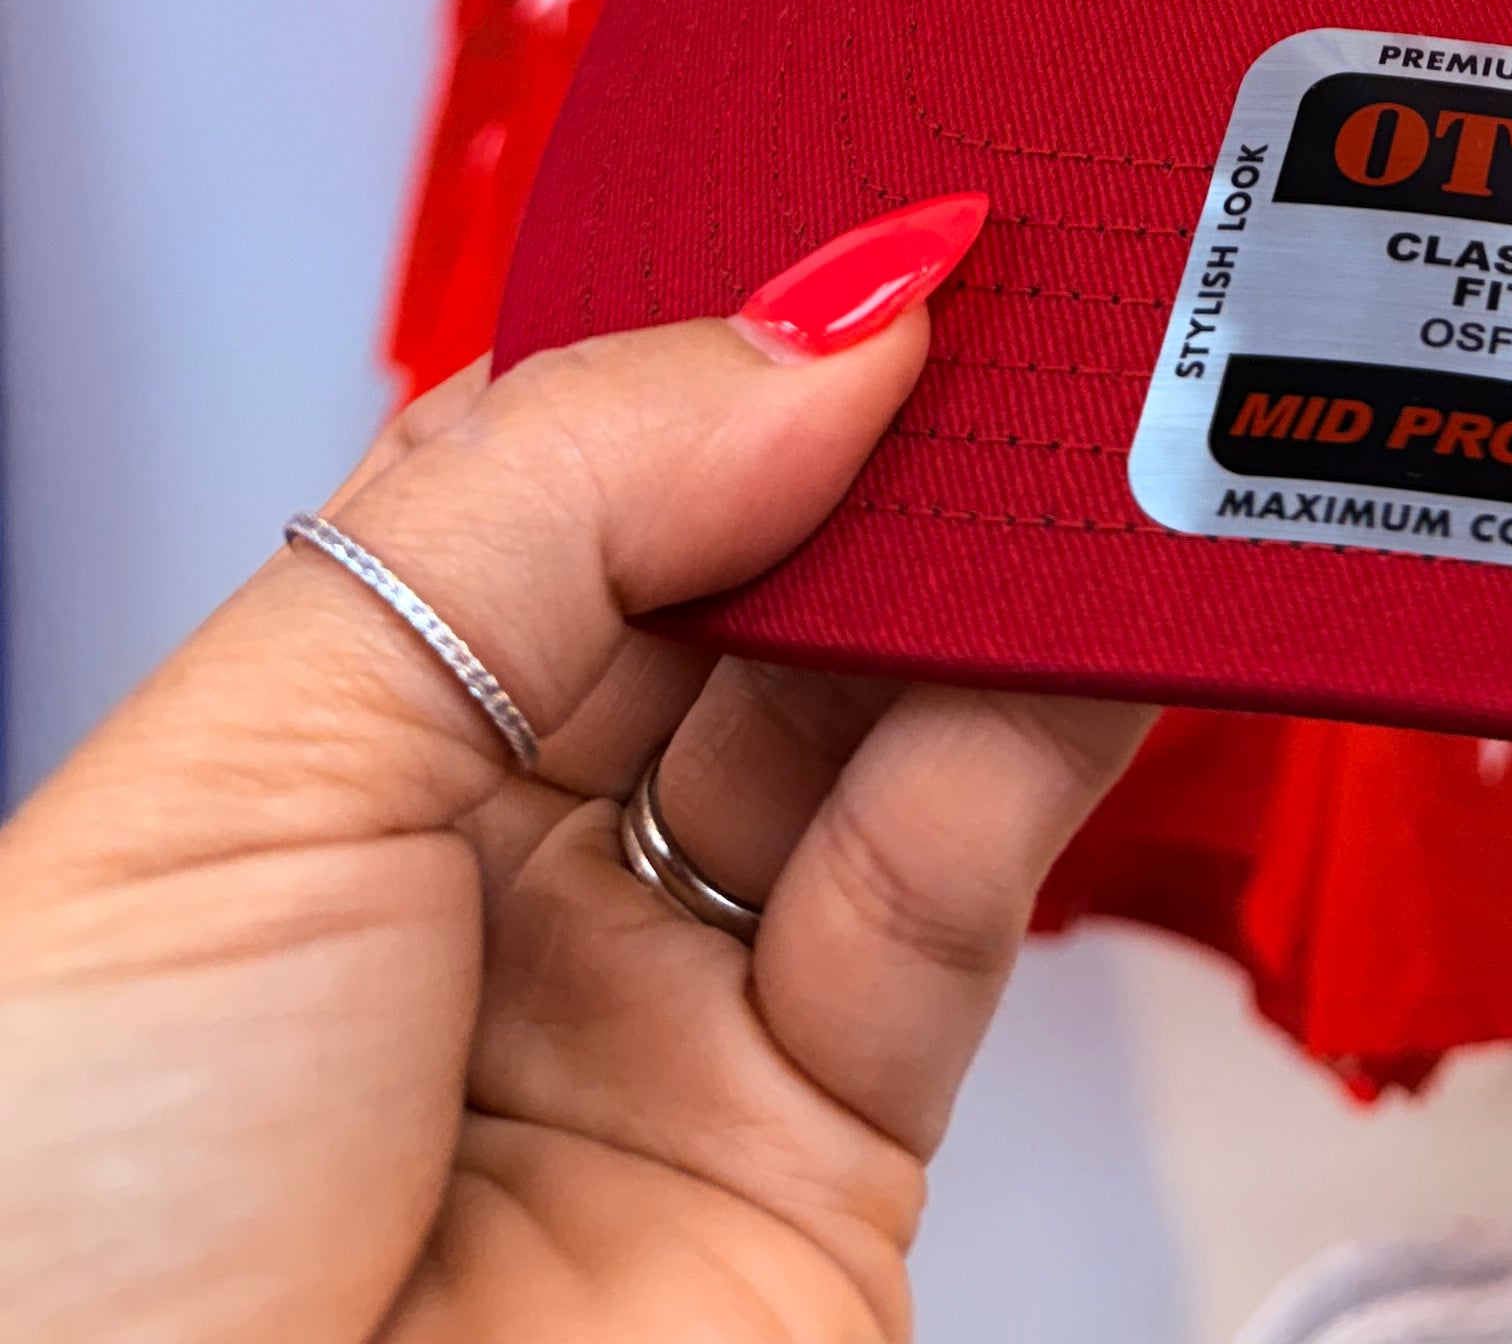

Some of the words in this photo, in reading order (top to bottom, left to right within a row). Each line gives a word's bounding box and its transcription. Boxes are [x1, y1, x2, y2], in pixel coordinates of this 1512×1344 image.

[1175, 245, 1240, 379] STYLISH
[1216, 143, 1269, 234] LOOK
[1228, 392, 1375, 444] MID
[1216, 489, 1453, 539] MAXIMUM
